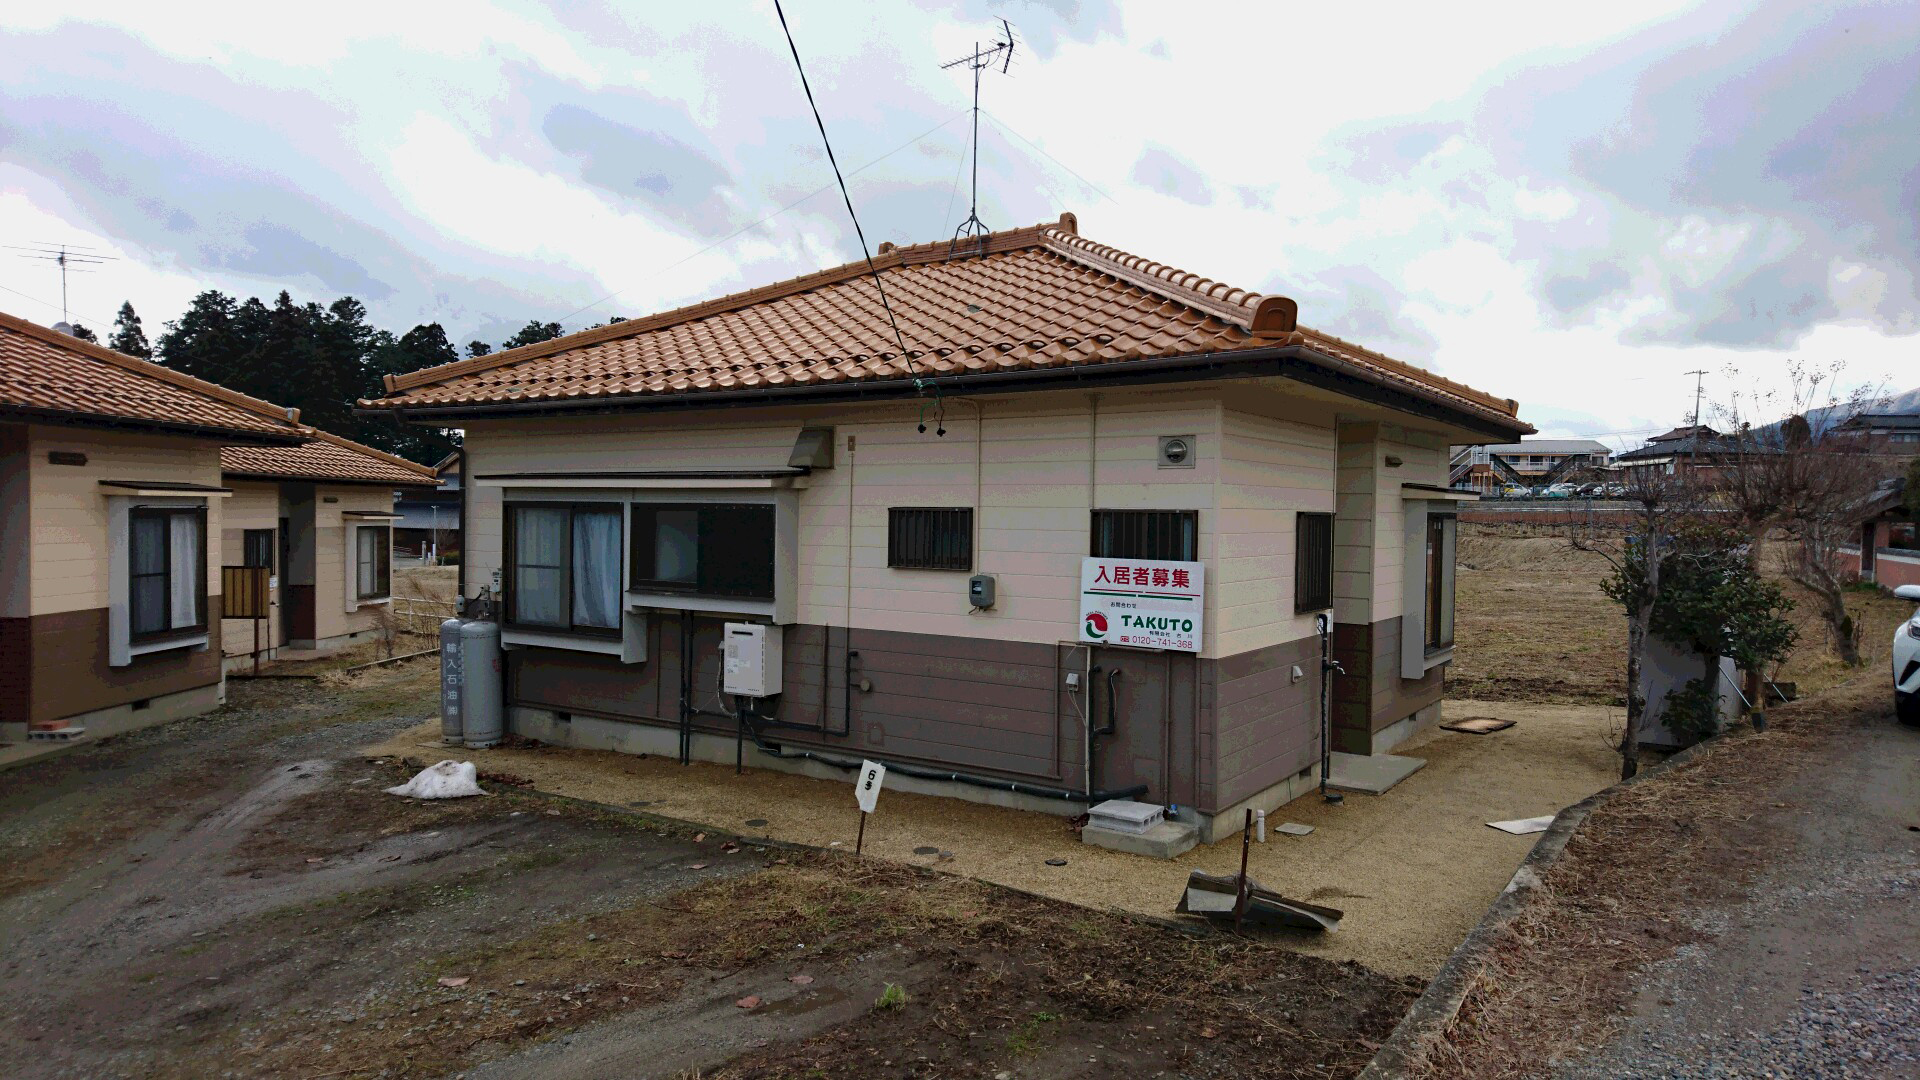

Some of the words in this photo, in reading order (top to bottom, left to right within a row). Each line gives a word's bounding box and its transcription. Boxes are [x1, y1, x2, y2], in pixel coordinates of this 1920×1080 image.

[1094, 565, 1190, 588] 入居者募集
[1121, 615, 1193, 632] TAKUTO
[1132, 635, 1193, 649] 0120-741-368
